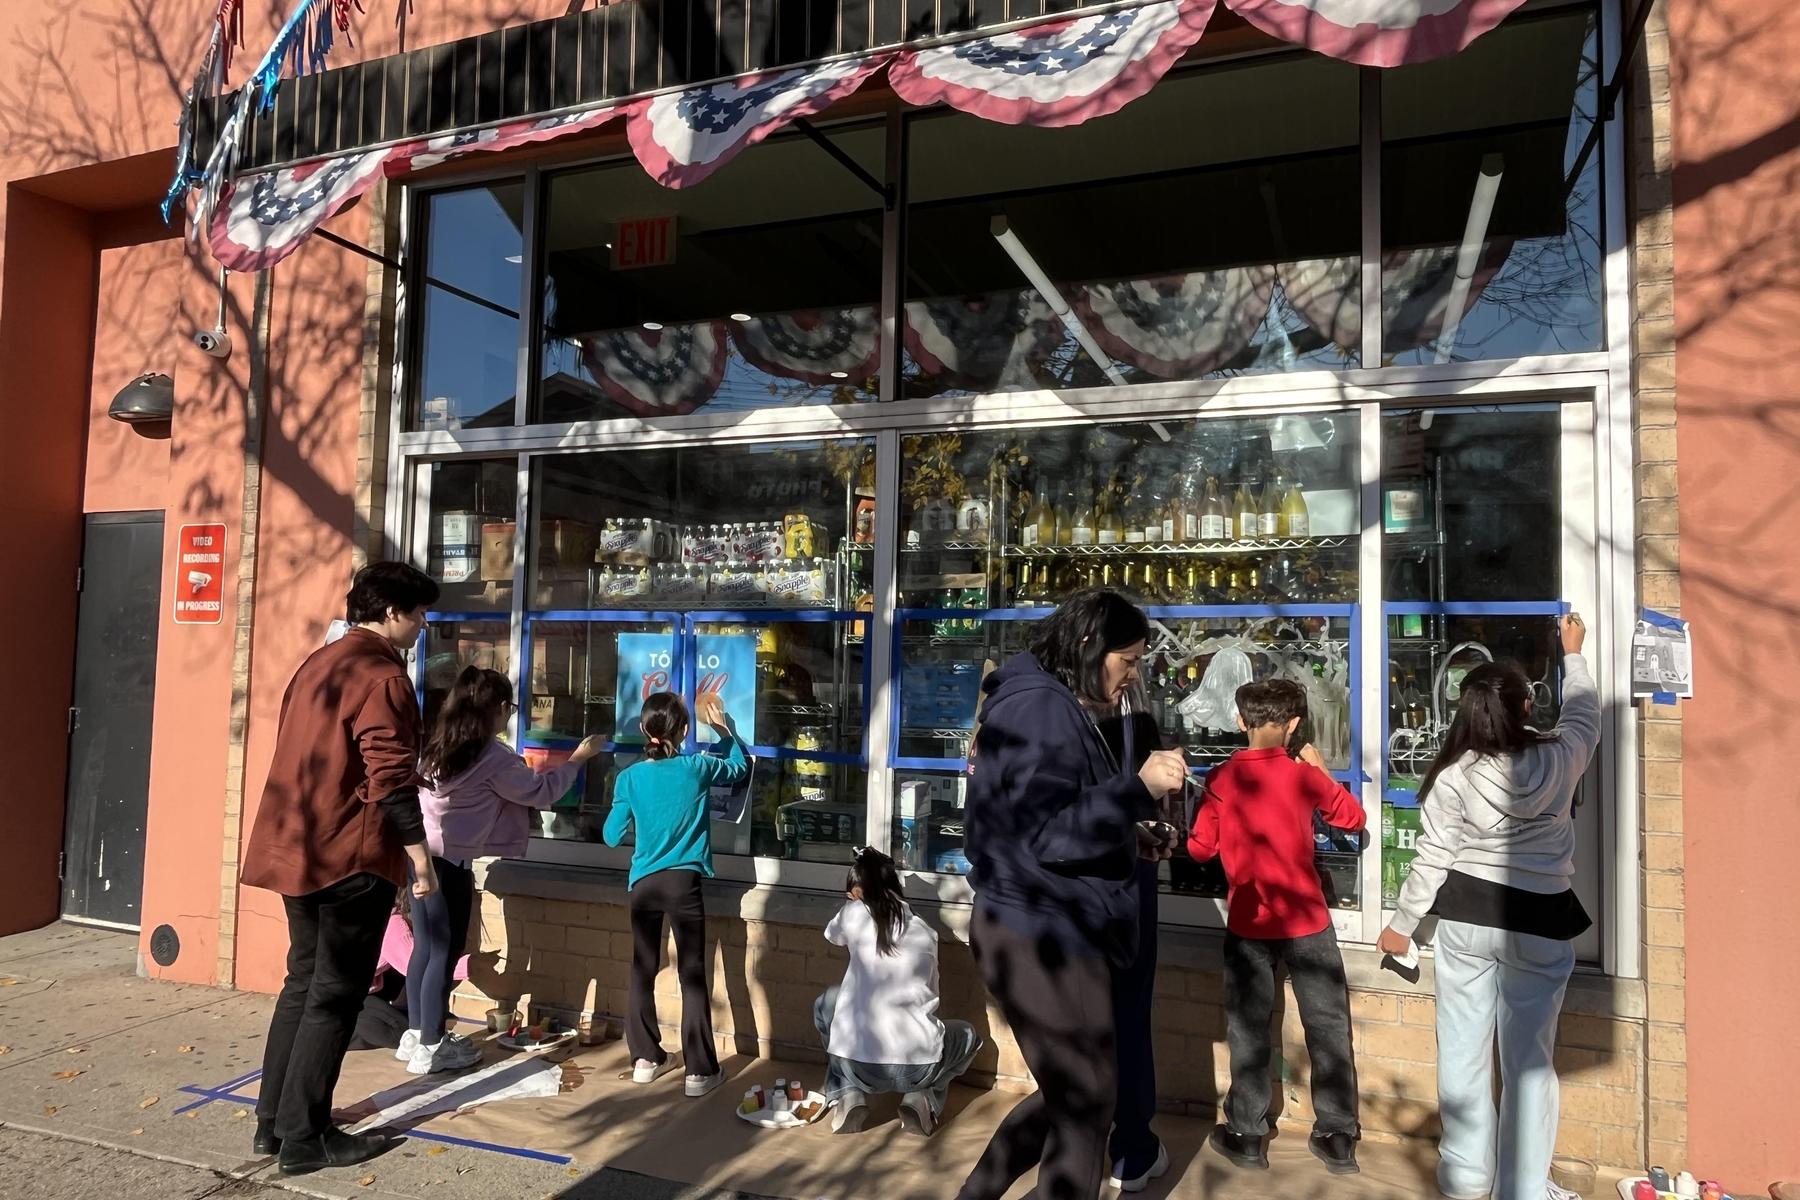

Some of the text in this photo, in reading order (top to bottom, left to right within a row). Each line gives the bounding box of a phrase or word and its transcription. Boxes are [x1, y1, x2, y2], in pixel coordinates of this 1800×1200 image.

[619, 217, 669, 266] EXIT
[192, 536, 213, 547] VIDEO
[606, 533, 638, 550] Snapple
[739, 534, 771, 551] Snapple
[183, 553, 220, 564] RECORDING
[606, 578, 637, 592] Snapple
[774, 576, 810, 593] Snapple
[177, 601, 220, 611] IN PROGRESS
[1400, 862, 1411, 870] 12
